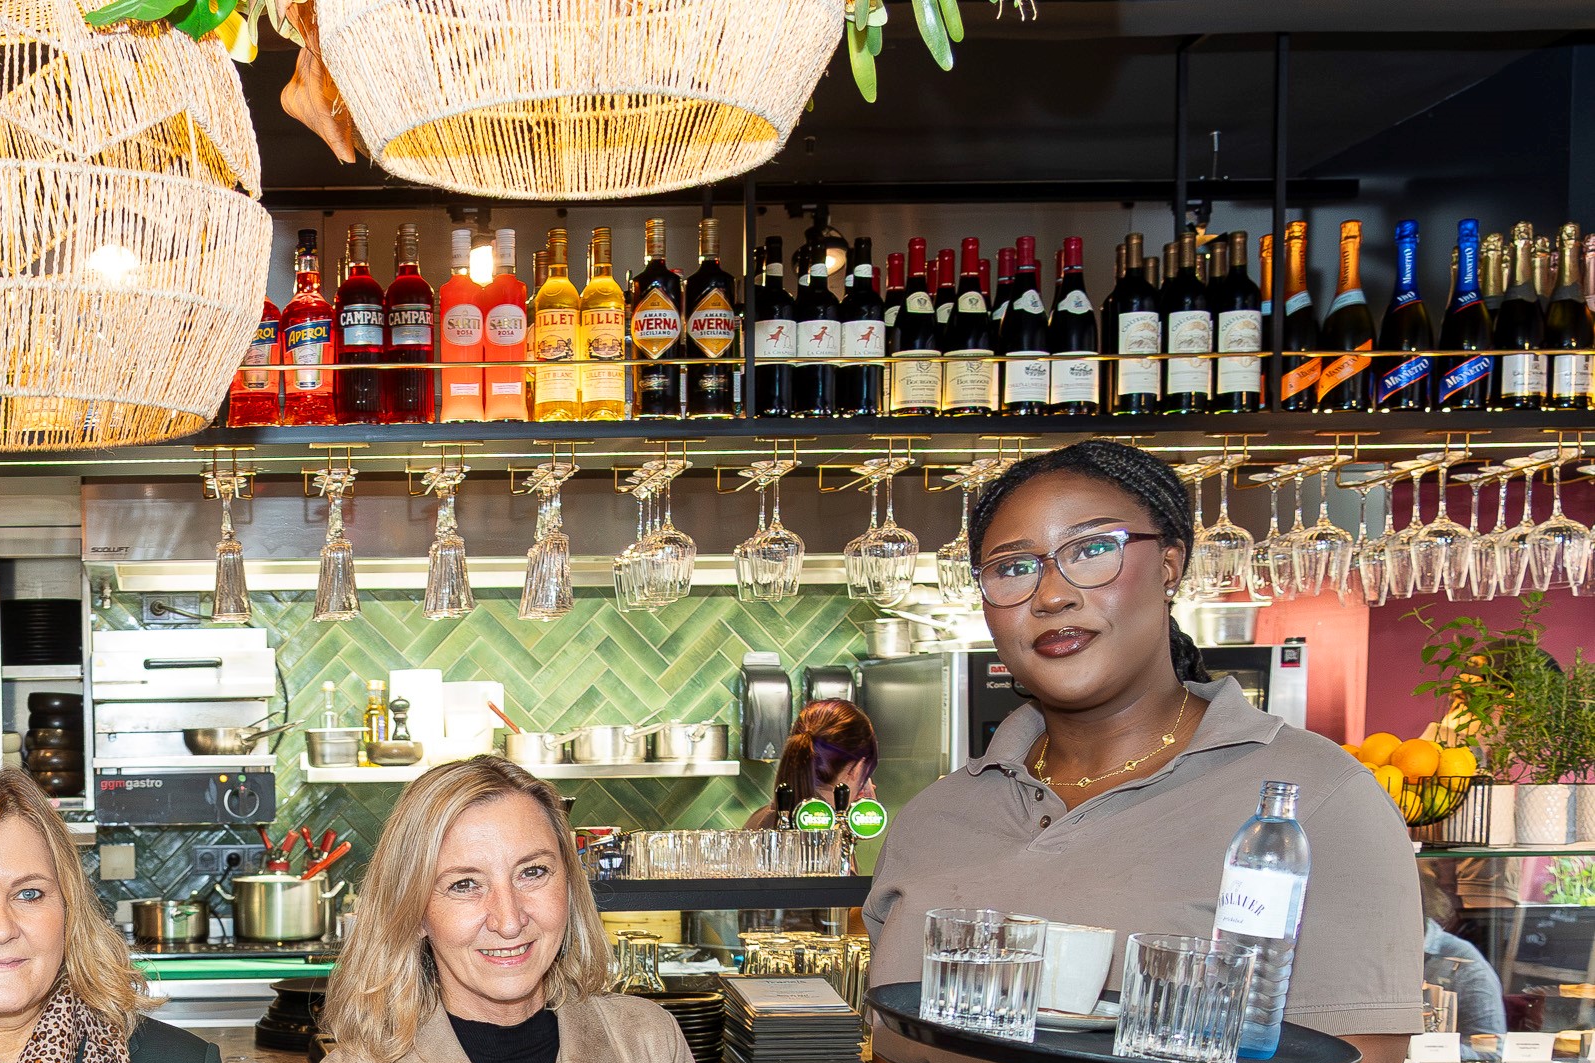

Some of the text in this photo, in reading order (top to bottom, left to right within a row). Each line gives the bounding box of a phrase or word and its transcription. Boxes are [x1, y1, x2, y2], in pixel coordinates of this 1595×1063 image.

[634, 318, 678, 333] AVERNA
[288, 327, 328, 347] APEROL
[100, 779, 163, 790] ggmgastro
